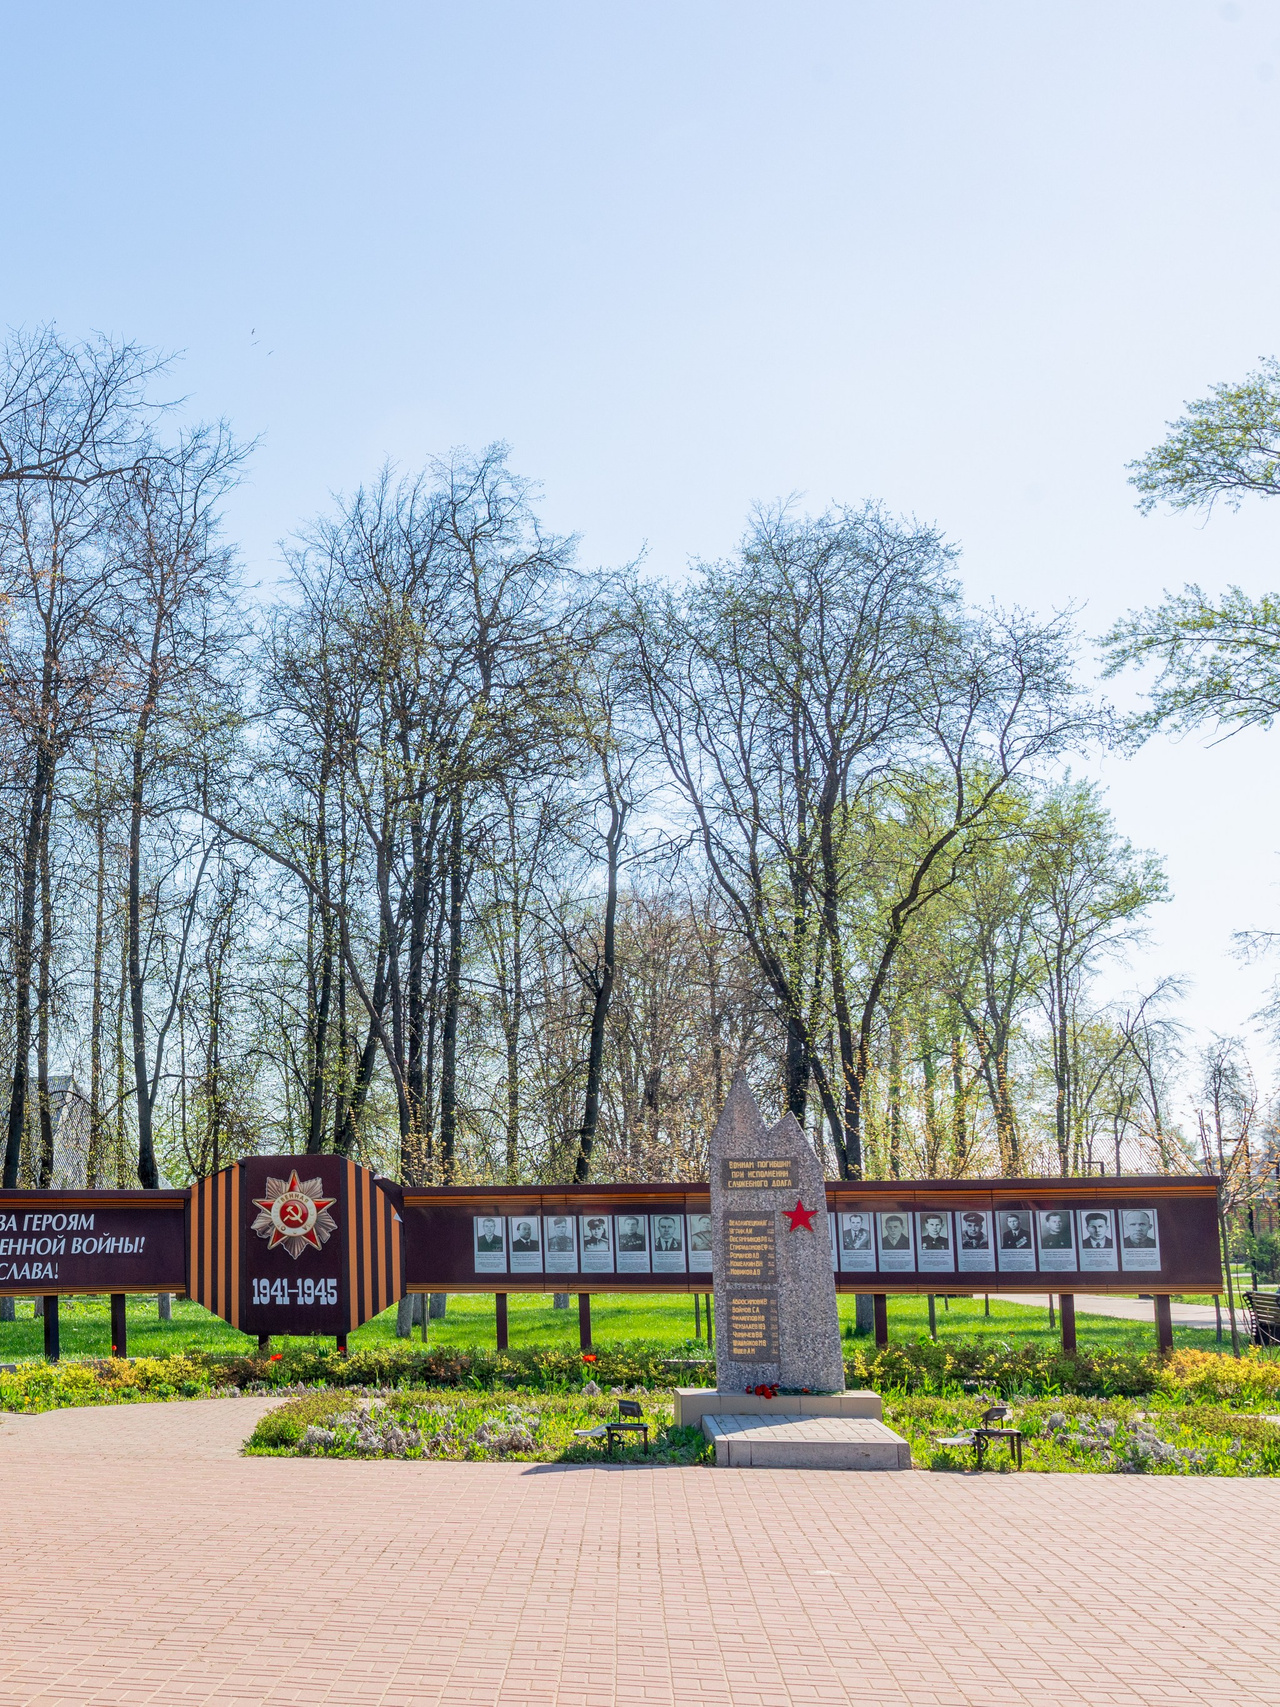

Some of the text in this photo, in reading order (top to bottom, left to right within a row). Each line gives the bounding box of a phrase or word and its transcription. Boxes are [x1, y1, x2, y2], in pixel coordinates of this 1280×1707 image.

[23, 1213, 95, 1232] ГЕРОЯМ
[71, 1232, 146, 1254] ВОЙНЫ!
[252, 1278, 338, 1305] 1941-1945
